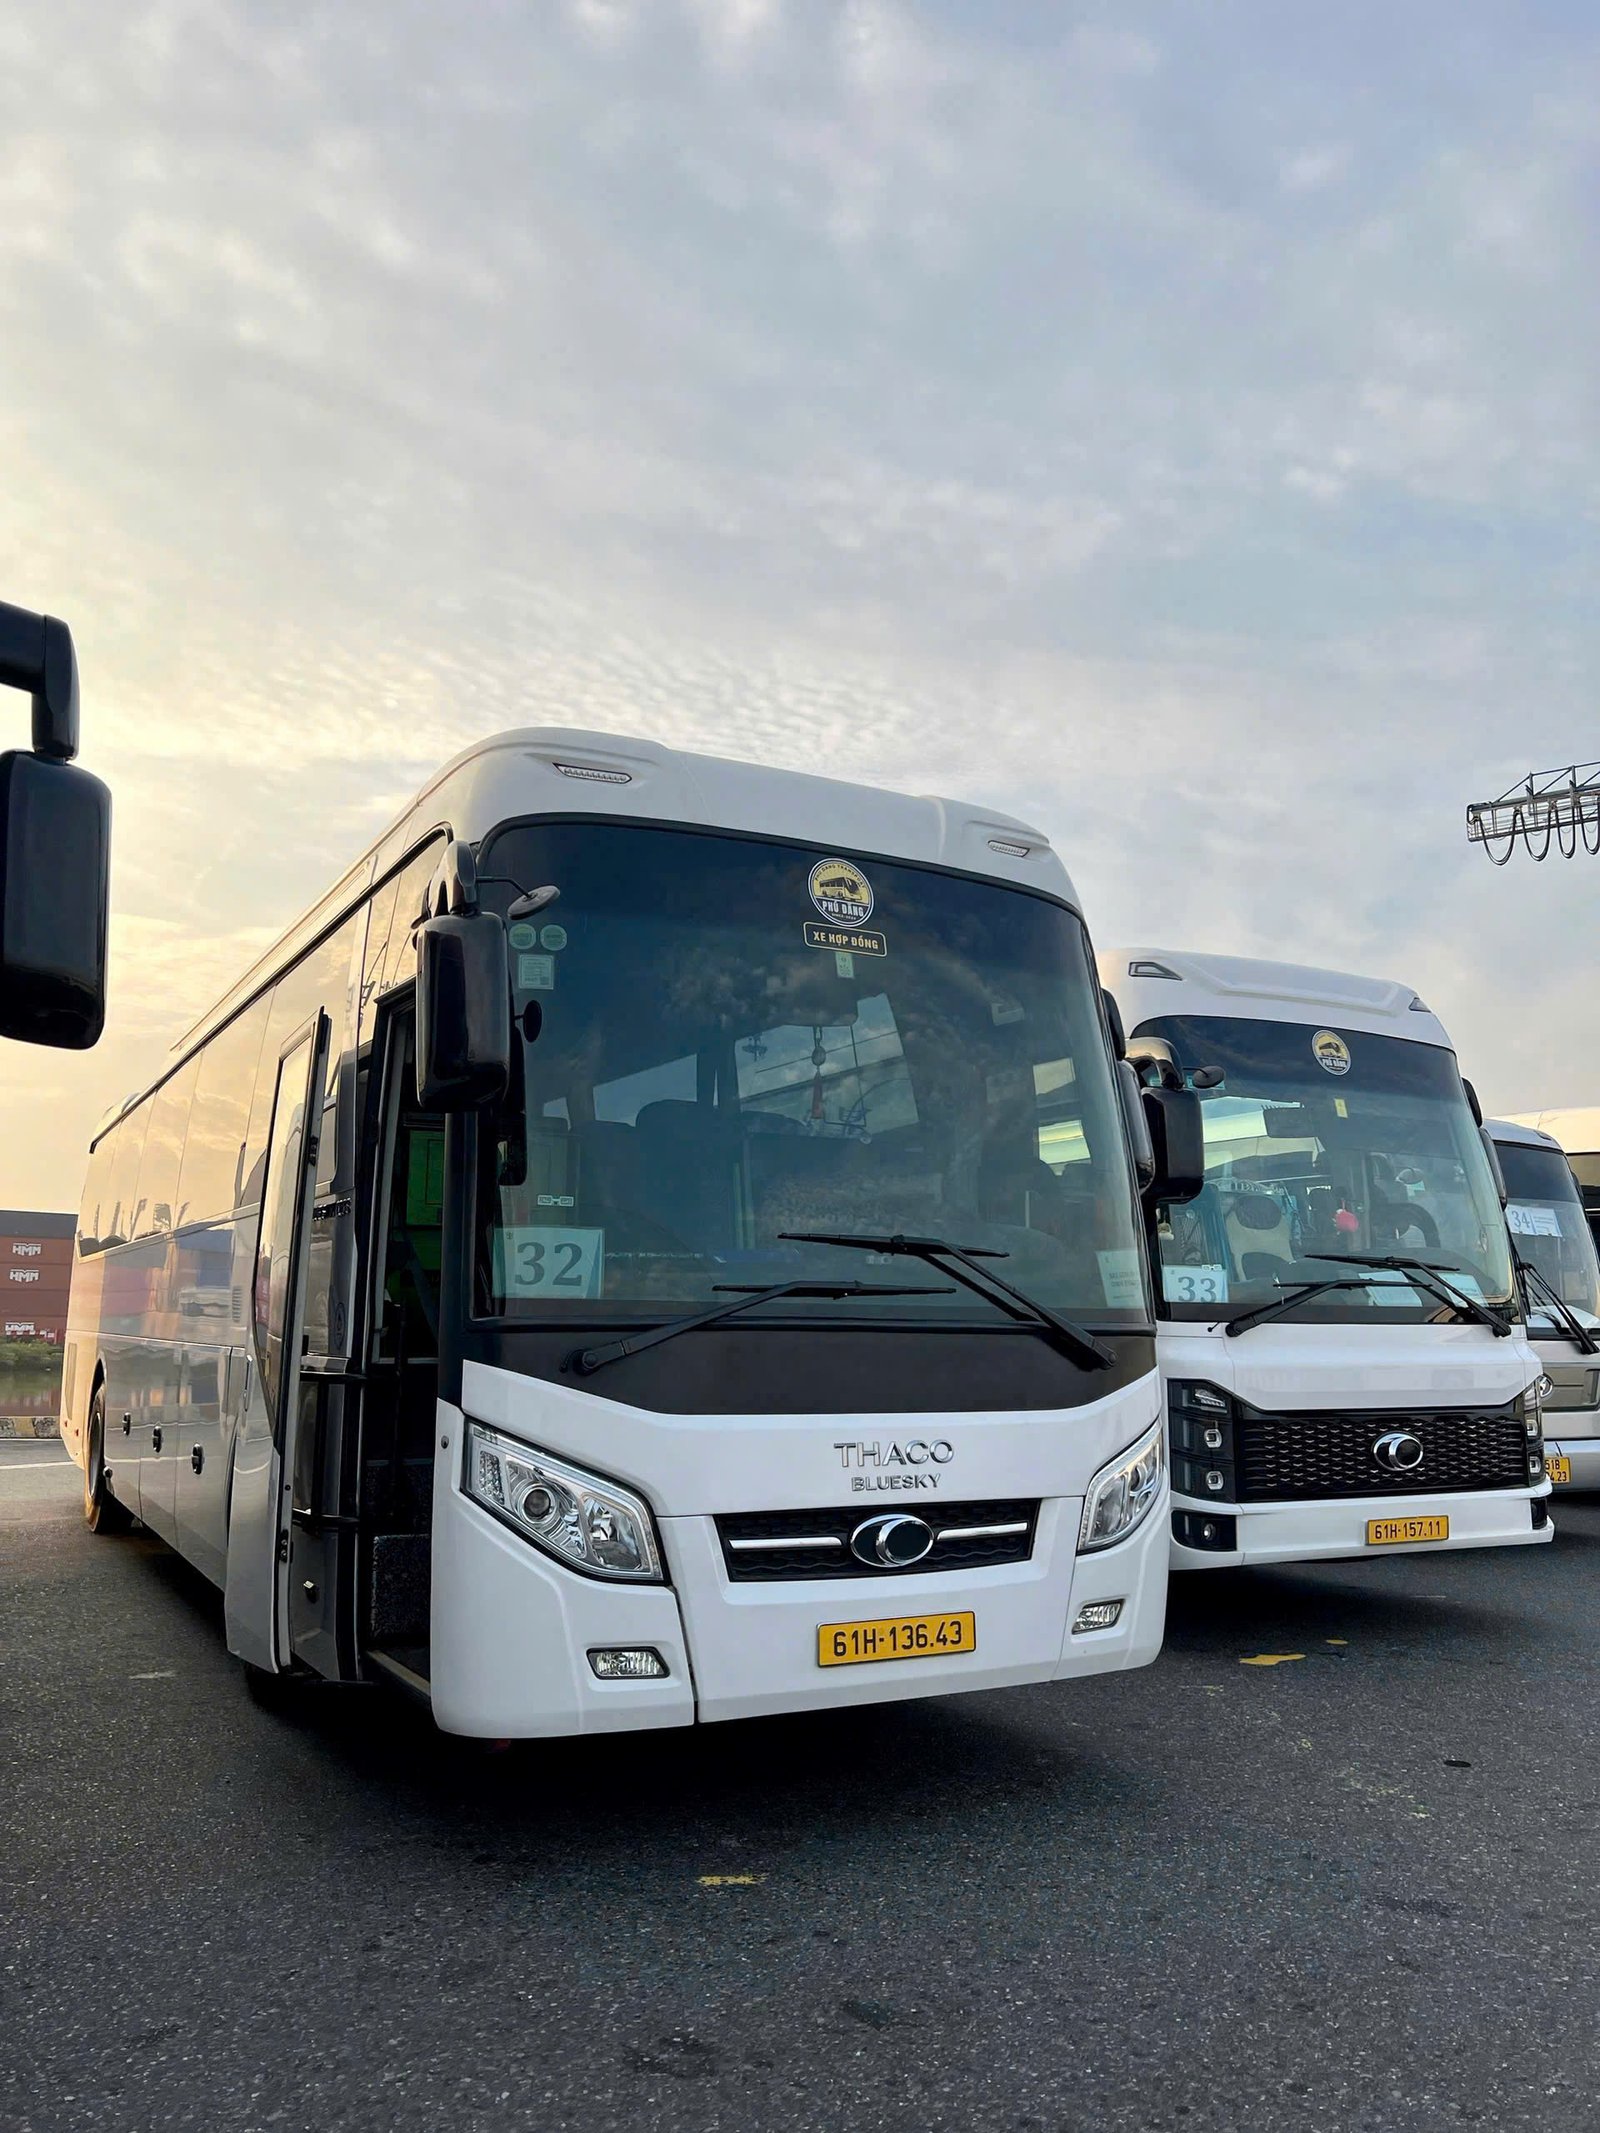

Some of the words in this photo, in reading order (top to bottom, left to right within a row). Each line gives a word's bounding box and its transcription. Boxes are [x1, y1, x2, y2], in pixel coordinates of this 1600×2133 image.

[812, 931, 826, 942] XE
[1511, 1210, 1531, 1229] 34
[12, 1243, 42, 1256] HMM
[515, 1242, 583, 1287] 32
[9, 1268, 40, 1283] HMM
[1178, 1276, 1217, 1303] 33
[833, 1439, 955, 1468] THACO
[851, 1473, 942, 1492] BLUESKY
[833, 1620, 962, 1657] 61H-136.43
